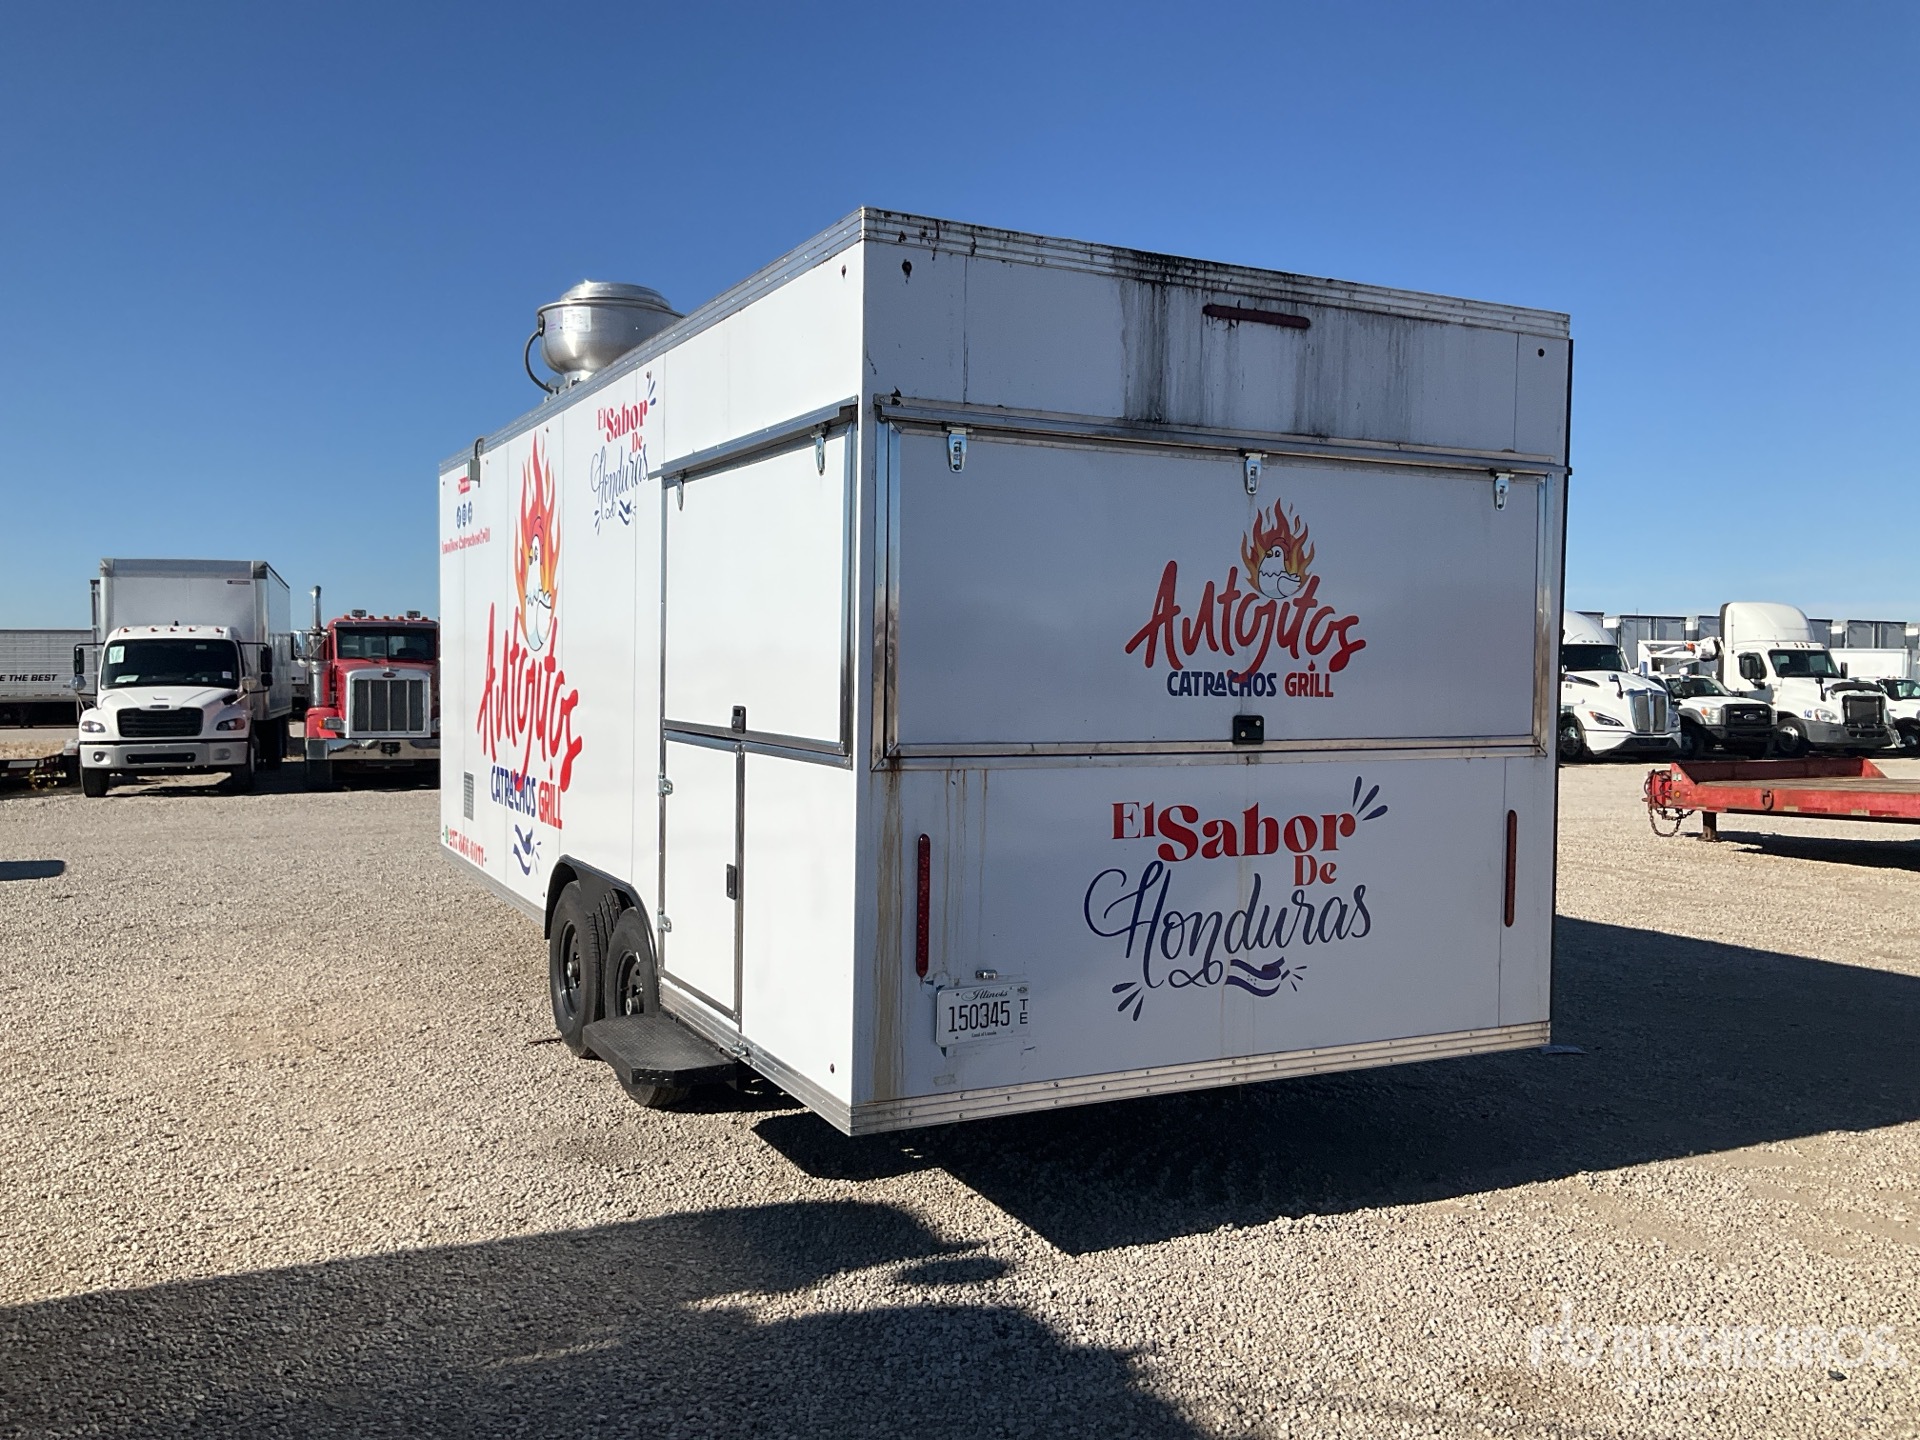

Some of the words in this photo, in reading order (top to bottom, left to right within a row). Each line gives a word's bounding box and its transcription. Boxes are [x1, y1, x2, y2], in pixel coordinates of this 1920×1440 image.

[606, 400, 648, 442] Sabor
[632, 431, 643, 452] De
[590, 443, 649, 520] Honduras
[9, 674, 29, 682] THE
[31, 673, 58, 682] BEST
[1166, 670, 1277, 697] CATRACHOS
[491, 764, 537, 818] CATRACHOS
[538, 780, 563, 829] GRILL
[1111, 801, 1157, 840] El
[1157, 801, 1357, 862] Sabor
[1293, 854, 1338, 887] De
[1084, 860, 1372, 989] Honduras
[961, 988, 1008, 1002] Illinois
[948, 1000, 1011, 1033] 150345
